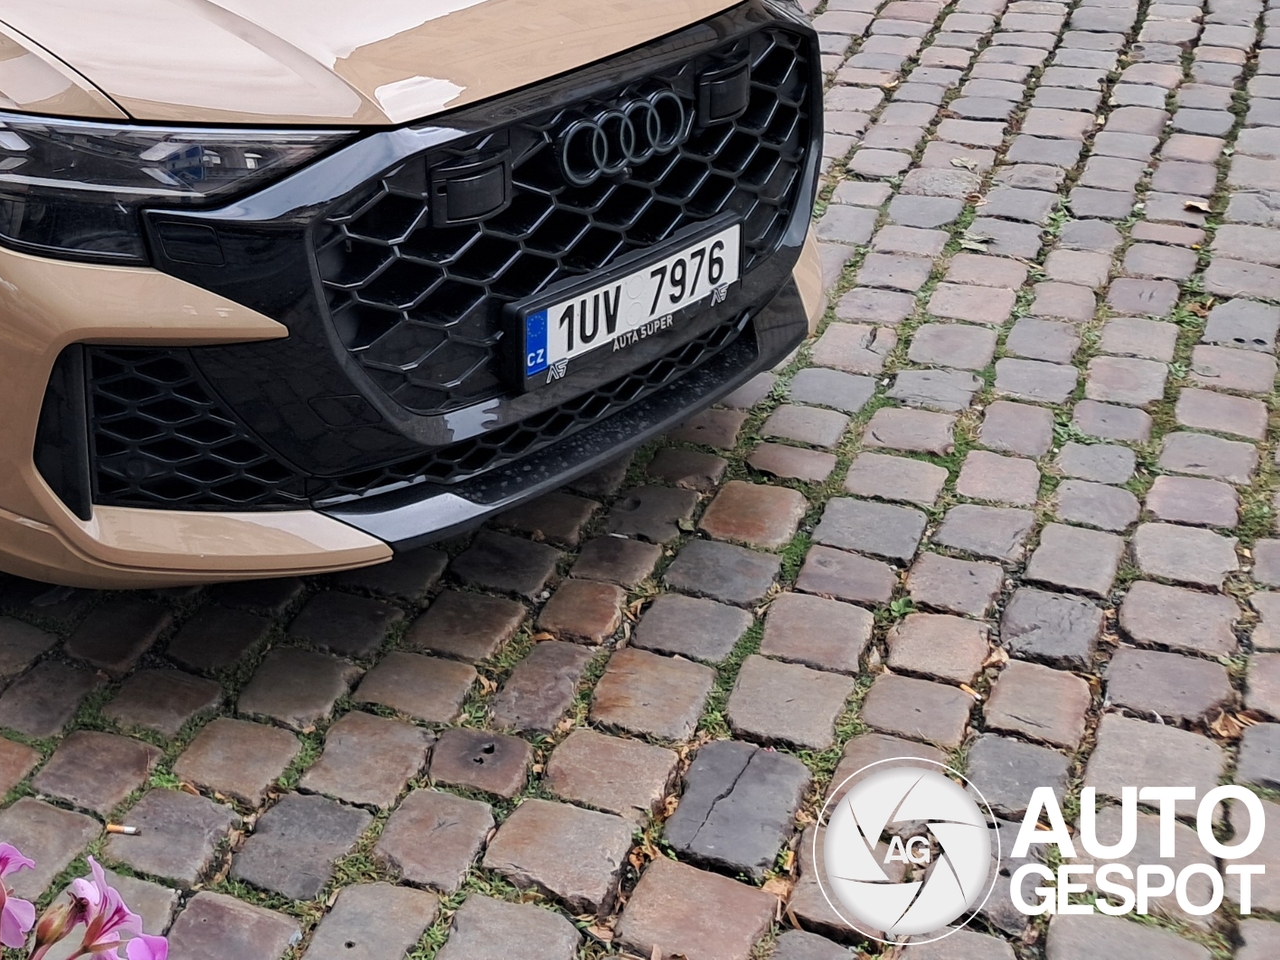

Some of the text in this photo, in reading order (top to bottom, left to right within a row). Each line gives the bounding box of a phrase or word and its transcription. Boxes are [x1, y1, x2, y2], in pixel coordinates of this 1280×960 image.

[558, 239, 726, 353] 1UV 7976
[612, 313, 674, 353] AUTA SUPER
[526, 347, 545, 367] CZ
